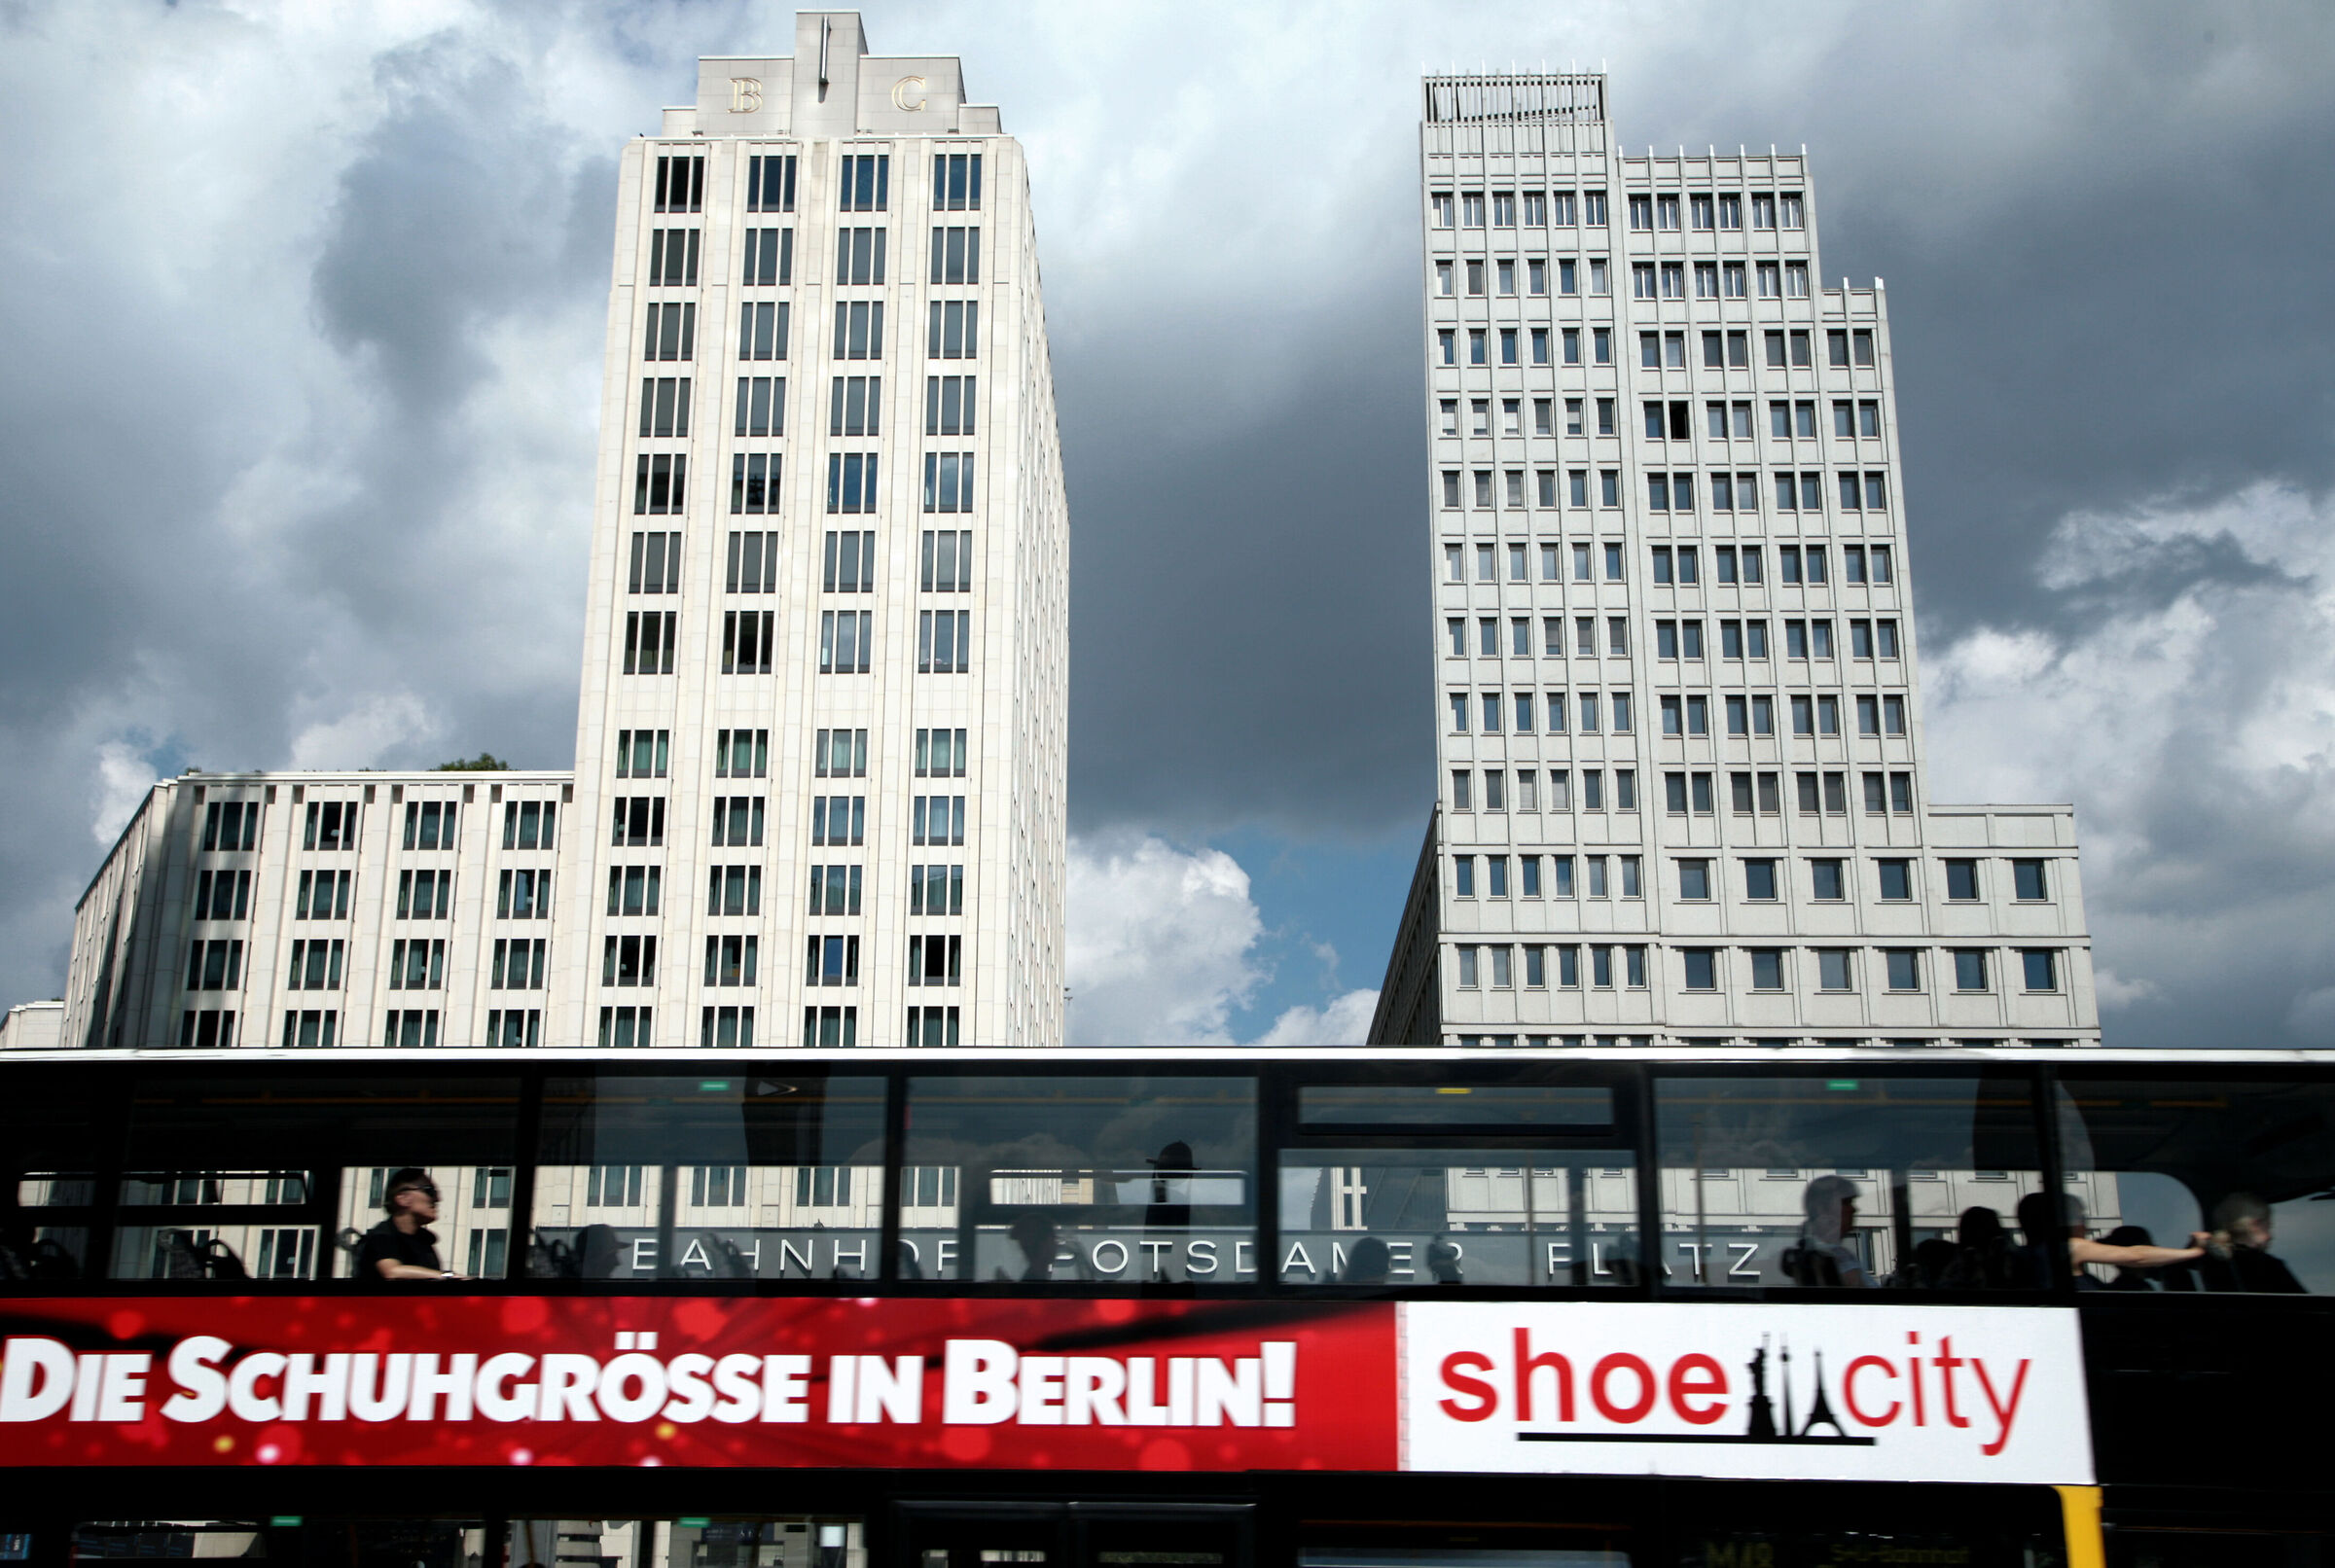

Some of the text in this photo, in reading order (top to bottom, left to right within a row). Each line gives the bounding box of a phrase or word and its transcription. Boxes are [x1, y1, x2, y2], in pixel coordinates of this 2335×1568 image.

[728, 78, 764, 114] B
[891, 75, 926, 111] C
[1547, 1242, 1761, 1275] PLTZ
[0, 1336, 152, 1422] DIE
[827, 1355, 924, 1424] IN
[943, 1338, 1297, 1427] BERLIN!
[1438, 1328, 2030, 1456] shoe city
